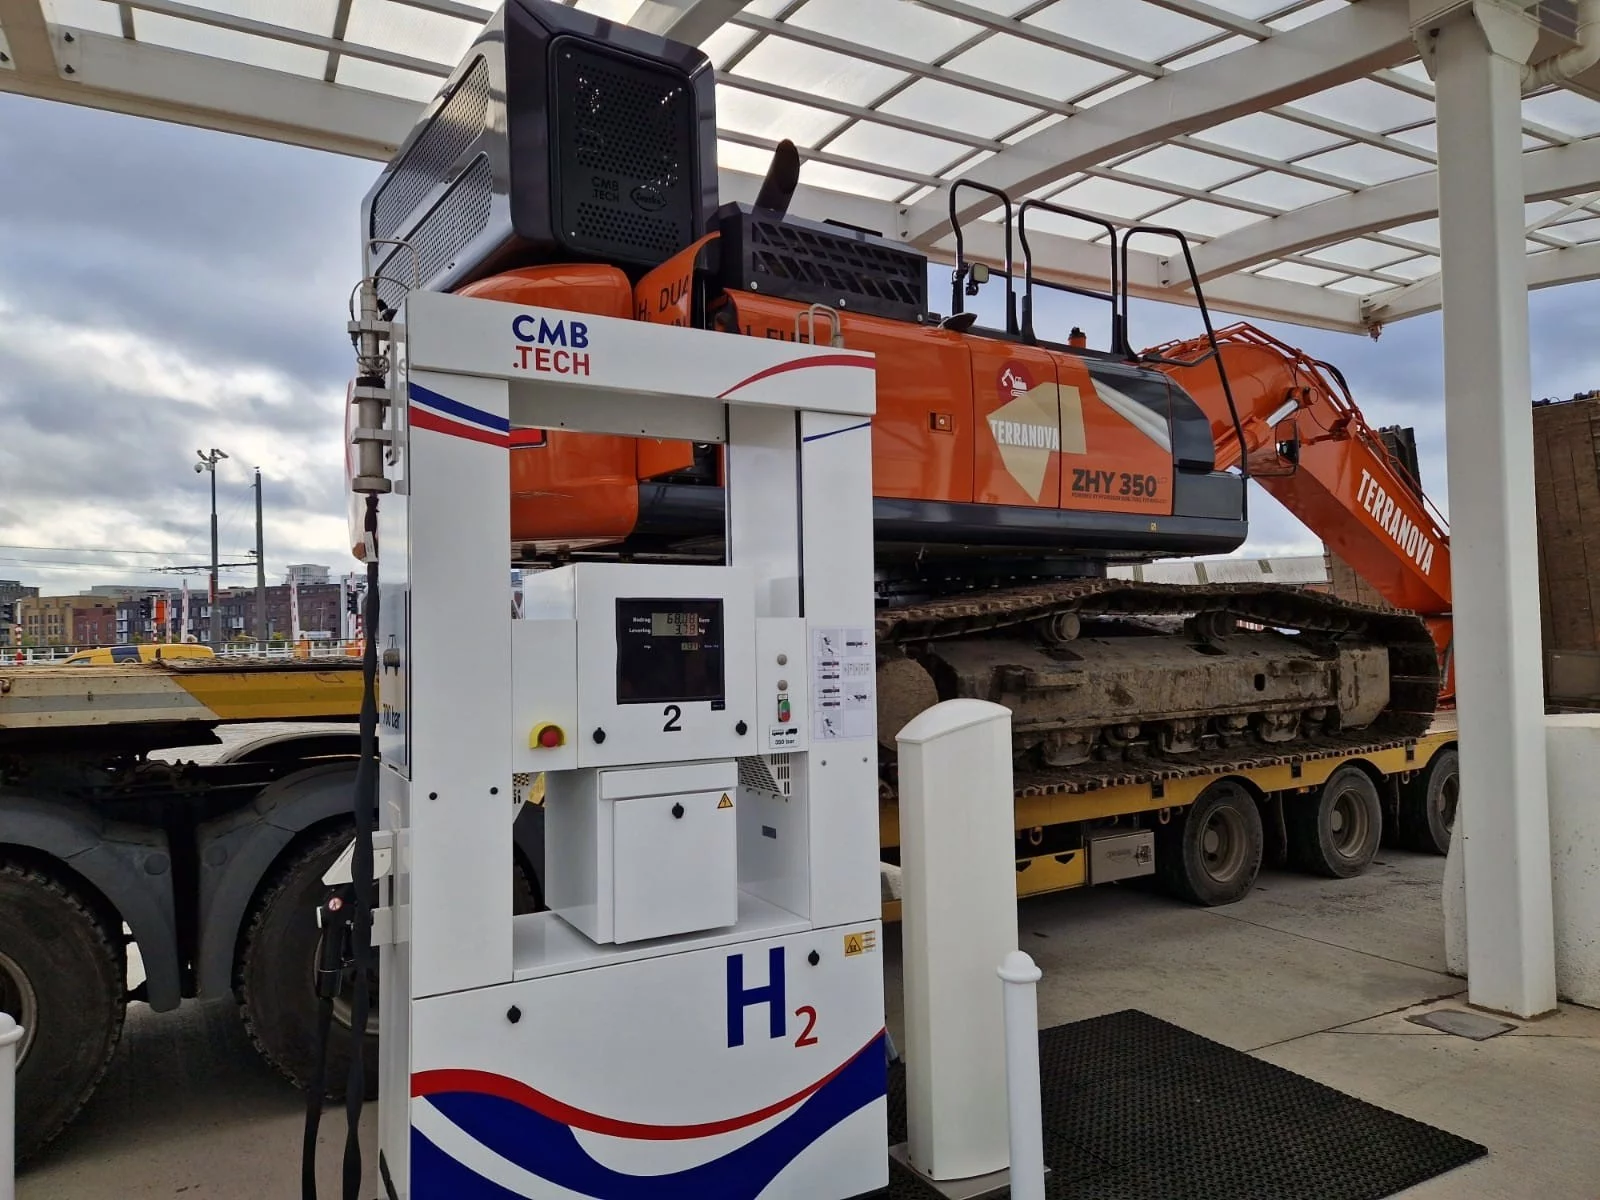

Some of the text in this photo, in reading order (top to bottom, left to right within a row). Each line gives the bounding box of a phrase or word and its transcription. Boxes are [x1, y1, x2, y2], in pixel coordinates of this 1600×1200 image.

[591, 176, 619, 191] CMB
[512, 314, 589, 349] CMB
[513, 345, 590, 376] .TECH
[990, 419, 1060, 450] TERRANOVA
[1072, 468, 1157, 498] ZHY 350
[1357, 468, 1434, 576] TERRANOVA
[392, 705, 400, 729] bar
[663, 704, 682, 732] 2
